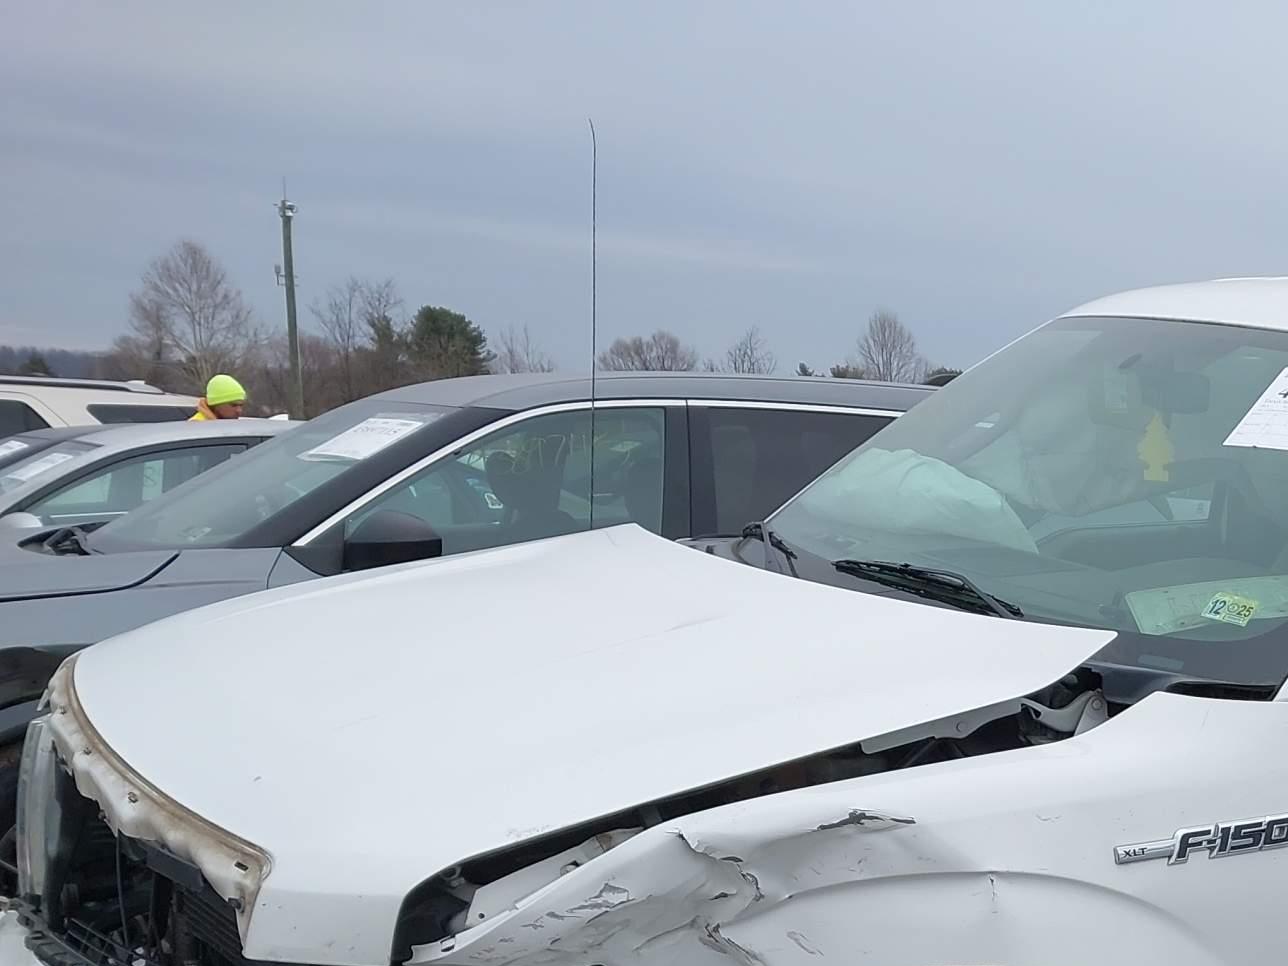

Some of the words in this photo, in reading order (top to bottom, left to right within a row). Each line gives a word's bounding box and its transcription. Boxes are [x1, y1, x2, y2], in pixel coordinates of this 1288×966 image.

[1208, 599, 1227, 615] 12
[1236, 604, 1255, 618] 25
[1123, 846, 1148, 859] XLT
